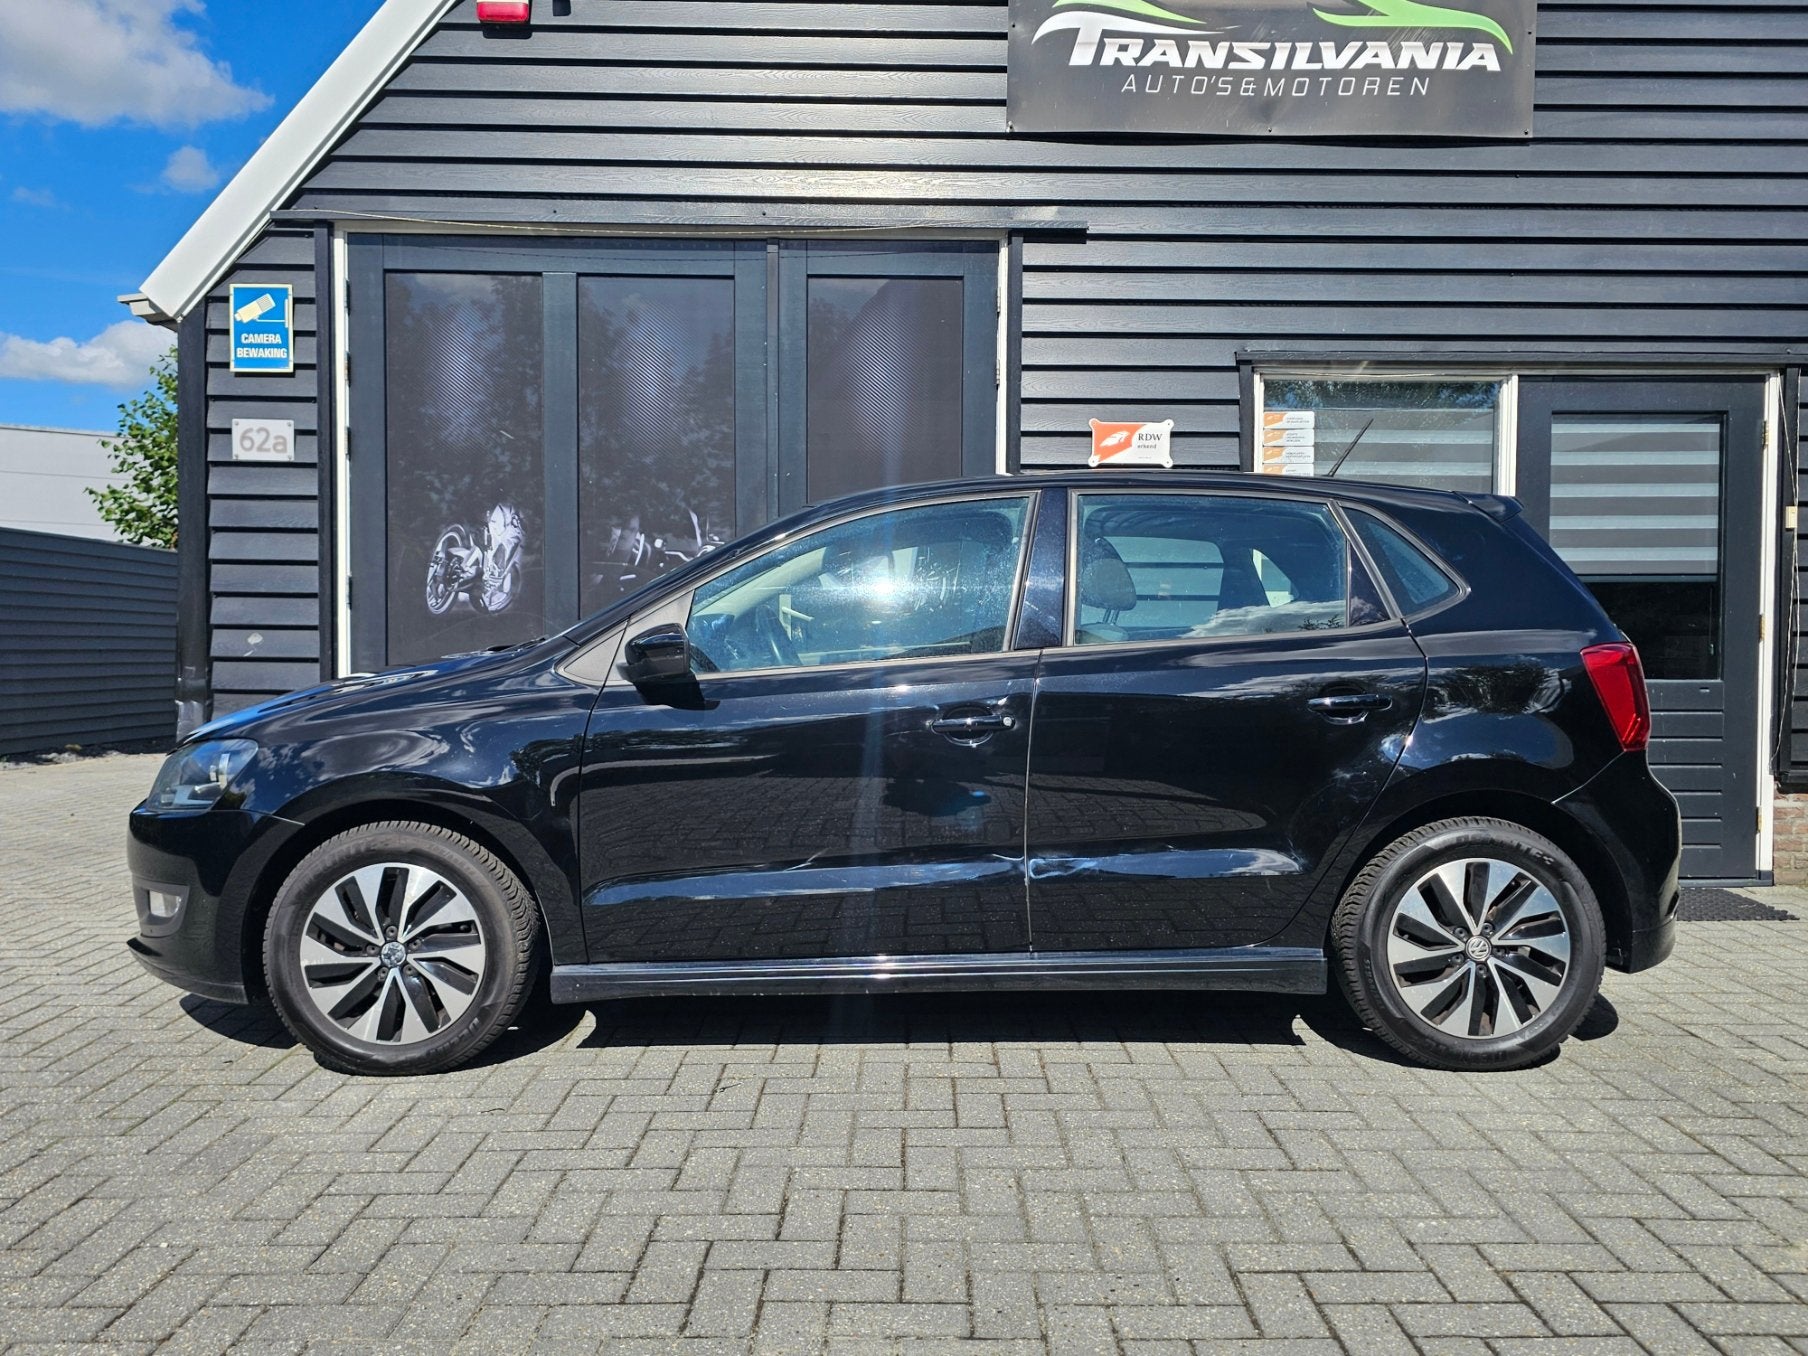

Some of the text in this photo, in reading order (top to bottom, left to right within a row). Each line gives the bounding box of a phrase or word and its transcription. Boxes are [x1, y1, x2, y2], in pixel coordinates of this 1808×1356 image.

[1032, 11, 1501, 72] TRANSILVANIA
[241, 333, 282, 344] CAMERA
[236, 347, 288, 359] BEWAKING
[239, 427, 288, 454] 62a
[1138, 433, 1163, 441] RDW
